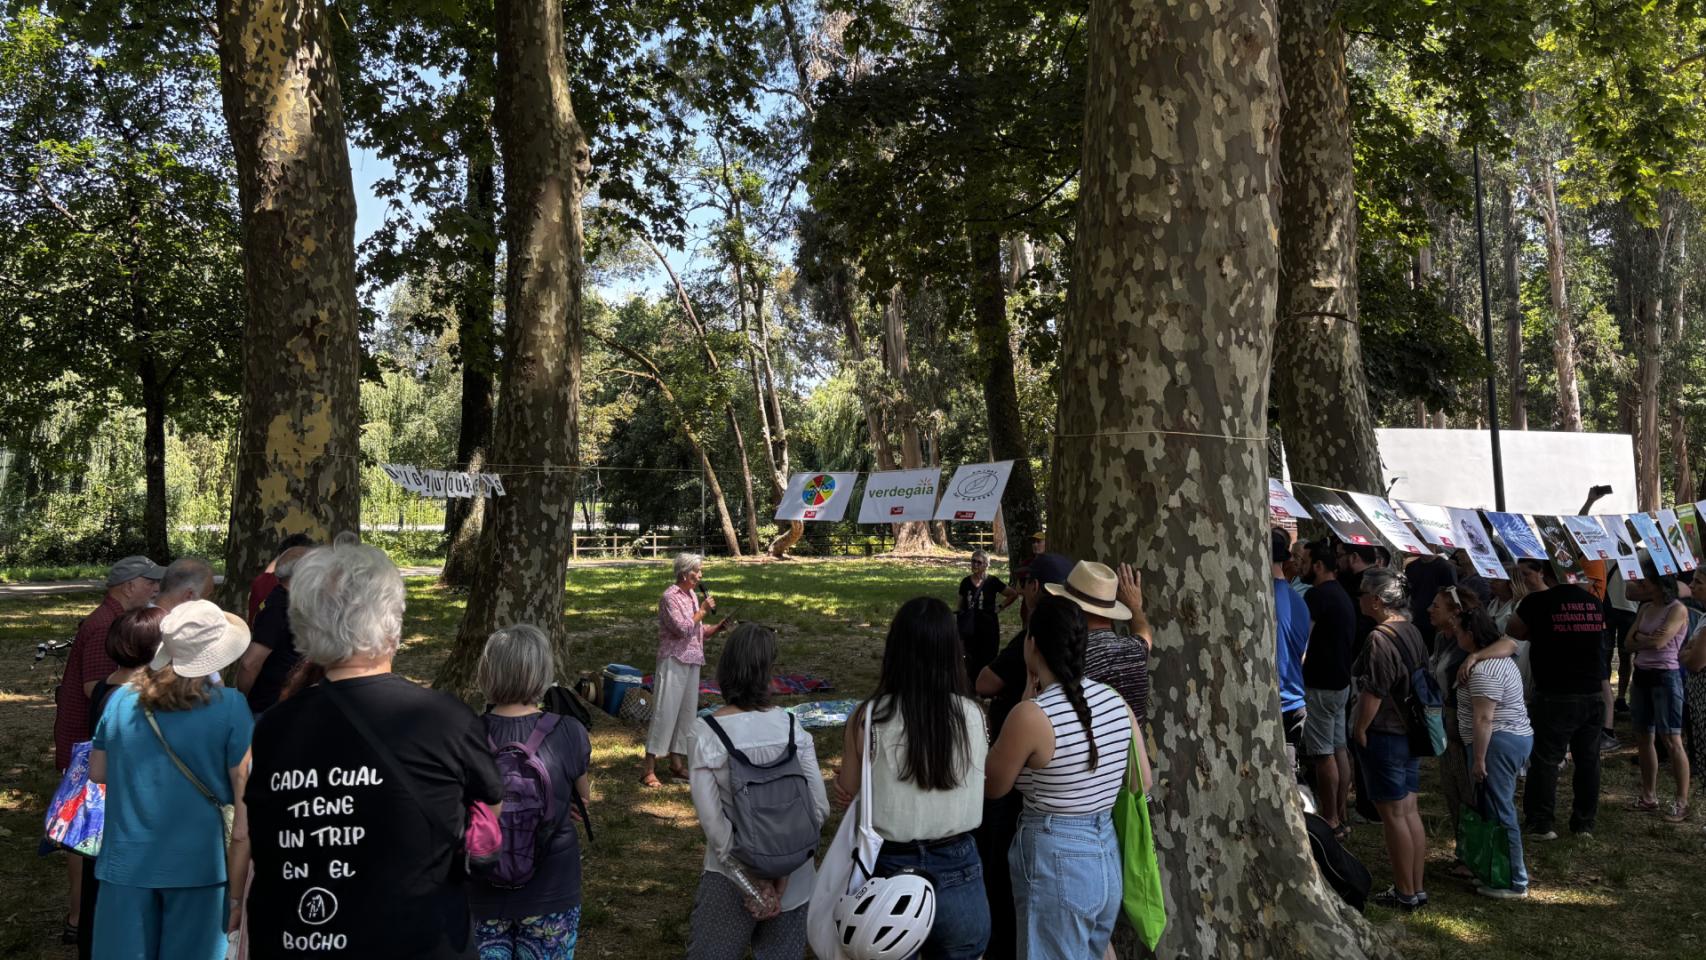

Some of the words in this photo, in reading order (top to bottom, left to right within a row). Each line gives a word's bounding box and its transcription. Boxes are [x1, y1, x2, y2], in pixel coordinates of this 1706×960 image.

[868, 484, 934, 499] verdegaia
[1552, 623, 1572, 632] POLA
[271, 769, 318, 791] CADA
[329, 766, 383, 786] CUAL
[288, 796, 353, 817] TIENE
[279, 829, 304, 848] UN
[311, 826, 365, 846] TRIP
[283, 862, 308, 879] EN
[329, 860, 355, 878] EL
[284, 932, 347, 950] BOCHO
